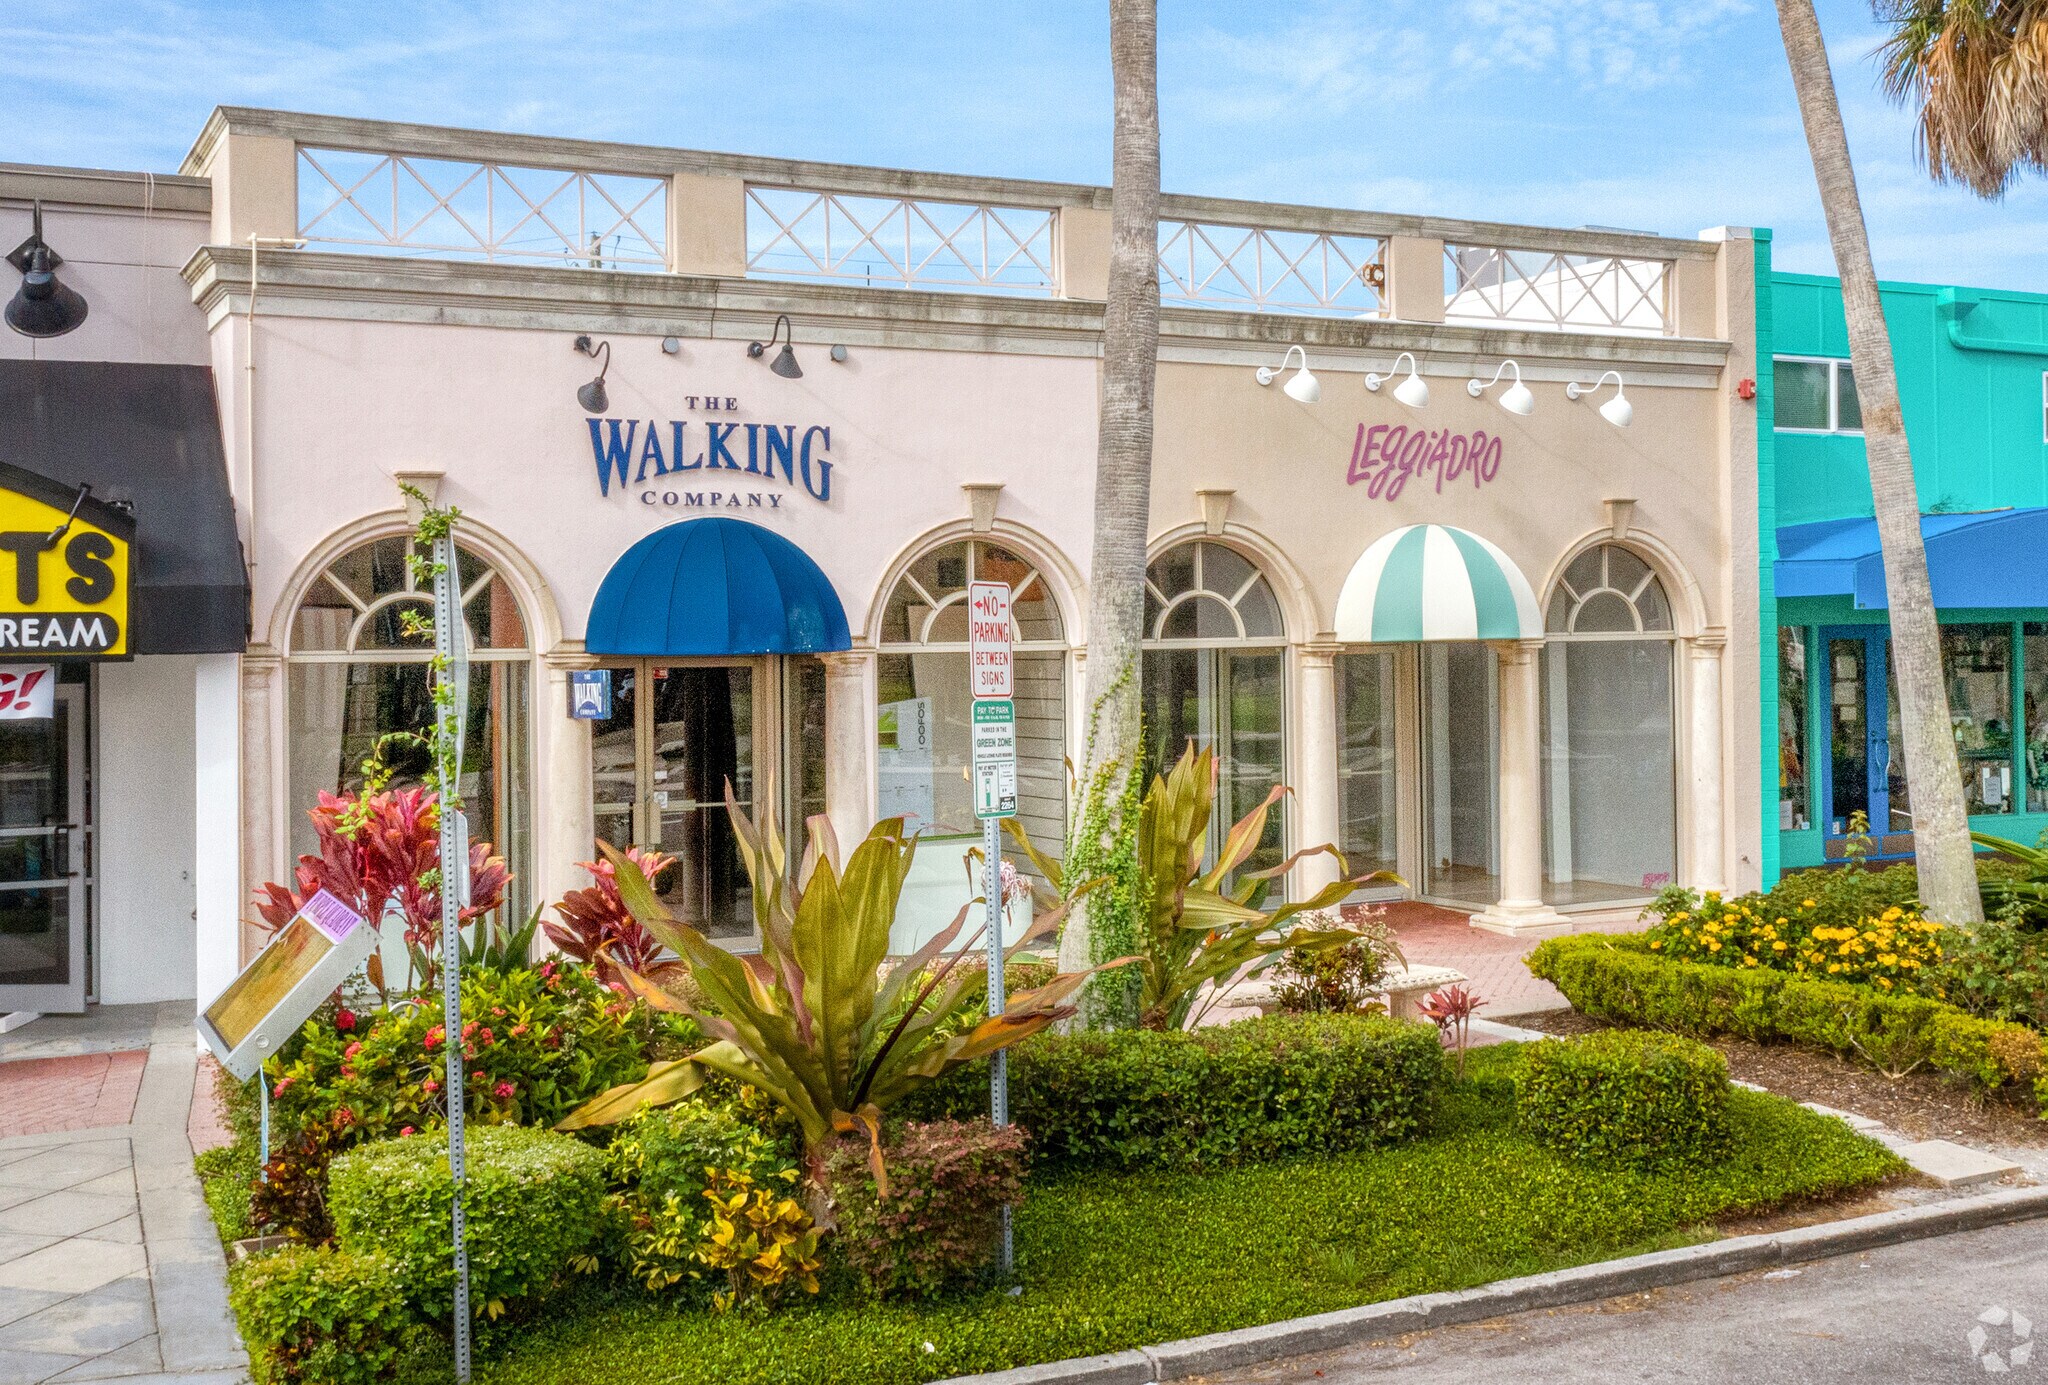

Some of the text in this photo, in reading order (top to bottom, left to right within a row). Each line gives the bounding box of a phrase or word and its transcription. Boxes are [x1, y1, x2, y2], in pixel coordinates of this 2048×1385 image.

[685, 396, 739, 411] THE
[585, 418, 834, 502] WALKING
[640, 490, 784, 508] COMPANY
[983, 596, 999, 617] NO
[974, 622, 1009, 643] PARKING
[976, 652, 1009, 666] BETWEEN
[981, 671, 1005, 686] SIGNS
[574, 683, 602, 713] WALKING
[977, 706, 987, 715] PAY
[996, 706, 1009, 714] PARK
[917, 701, 926, 745] OOFOS
[976, 737, 1012, 748] GREEN ZONE
